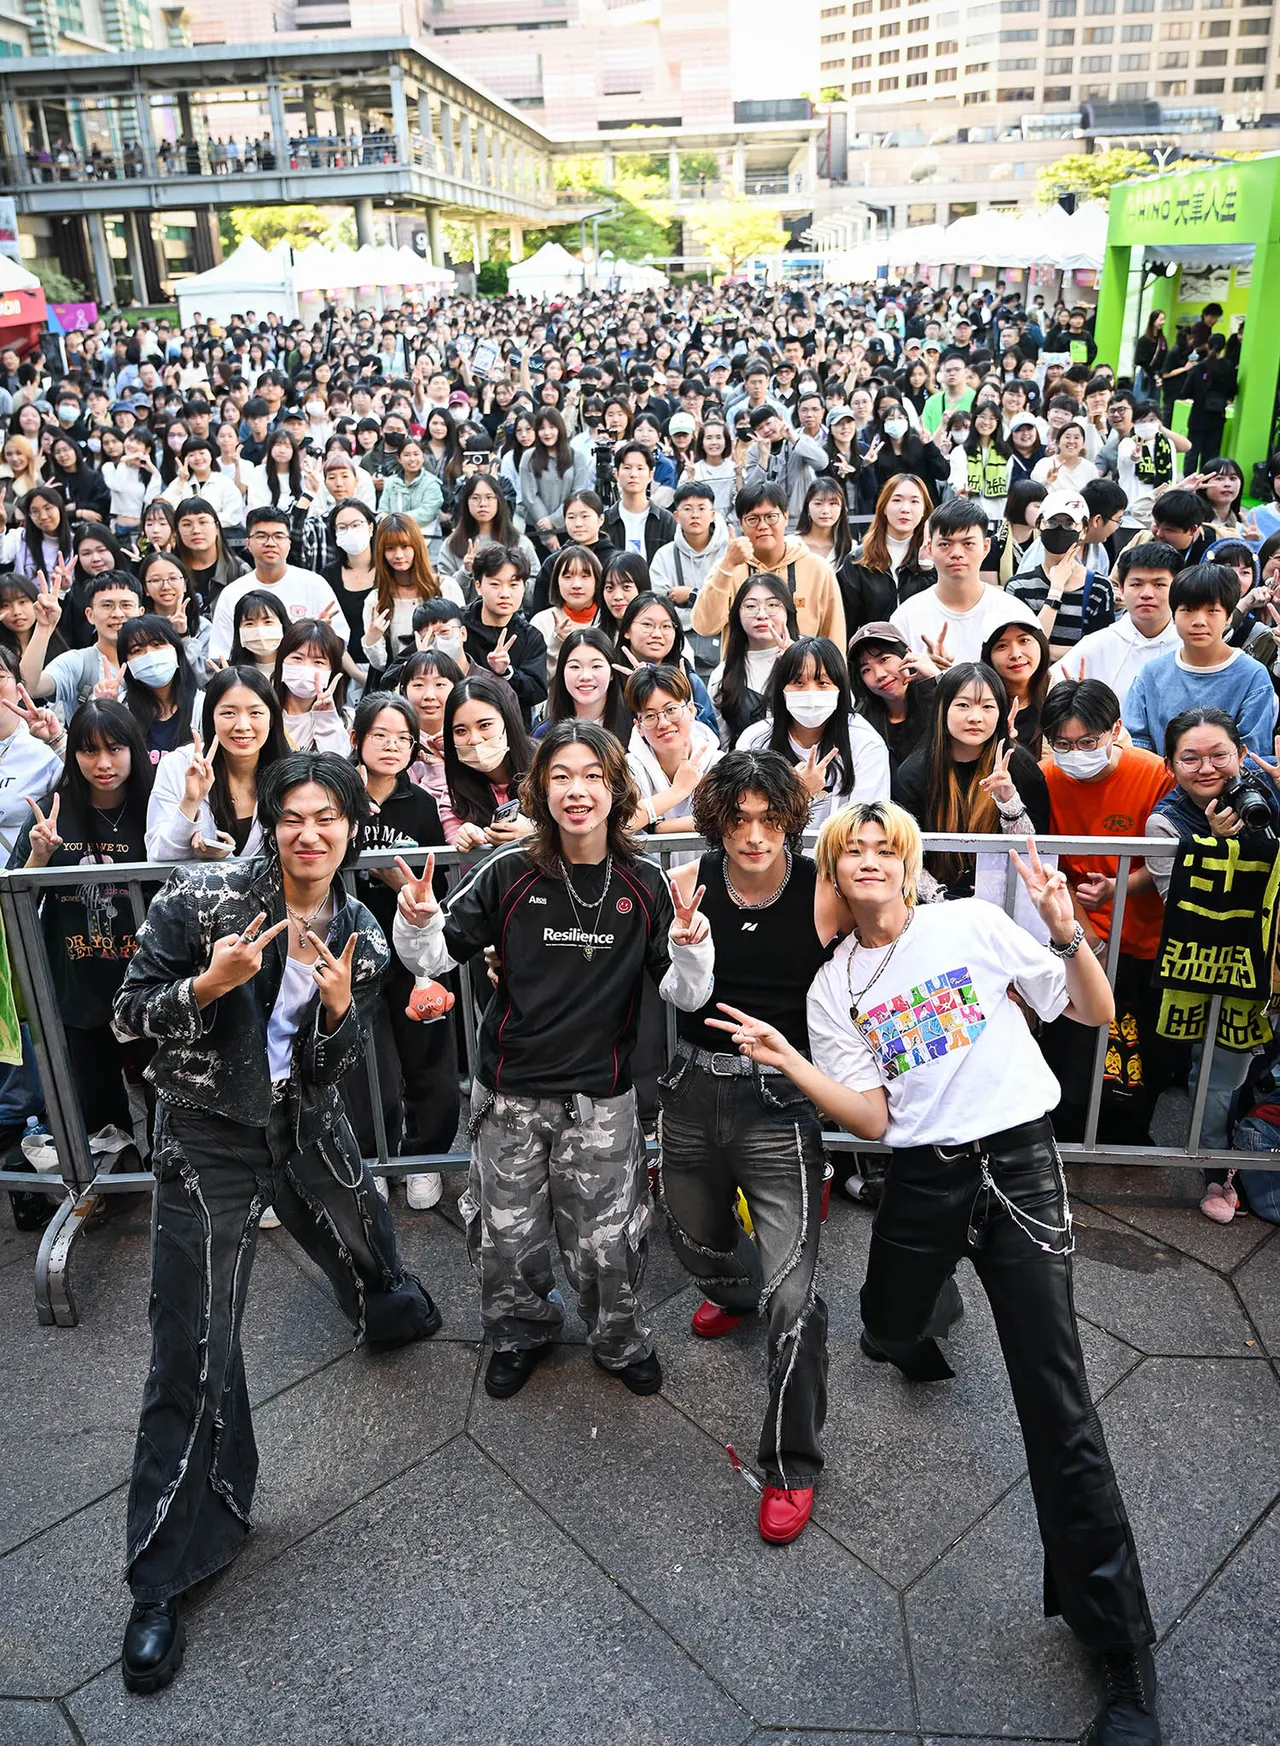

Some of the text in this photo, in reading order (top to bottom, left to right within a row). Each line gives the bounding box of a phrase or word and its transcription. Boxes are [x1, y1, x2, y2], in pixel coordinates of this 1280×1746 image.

[63, 842, 83, 851] YOU
[116, 843, 129, 853] TO
[543, 927, 614, 944] Resilience
